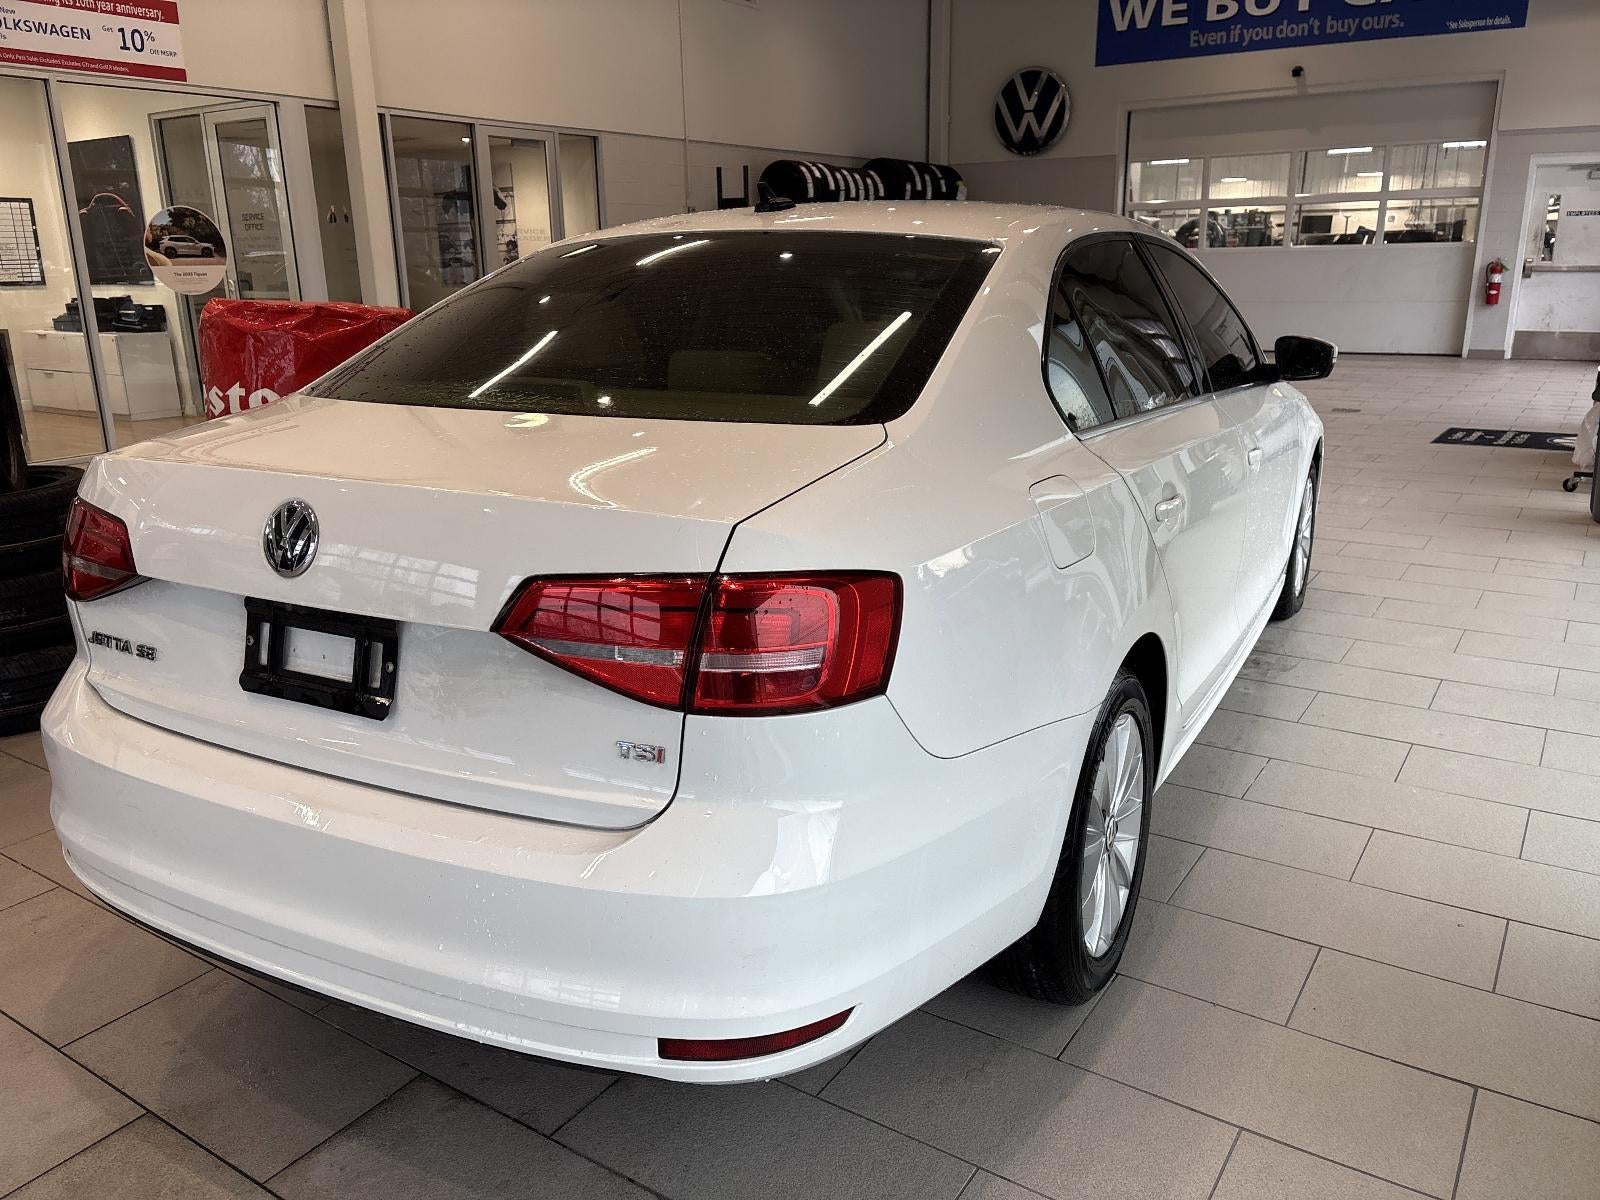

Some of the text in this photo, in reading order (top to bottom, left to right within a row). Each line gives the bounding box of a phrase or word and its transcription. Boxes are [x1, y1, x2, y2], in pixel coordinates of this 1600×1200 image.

[96, 0, 114, 12] year
[116, 3, 165, 21] anniversary.
[0, 17, 91, 40] LKSWAGEN
[1189, 14, 1404, 48] Even if you don't buy ours.
[241, 213, 264, 221] SERVICE
[245, 223, 264, 231] OFFICE
[88, 630, 133, 655] JETTA
[616, 740, 665, 764] TSI
